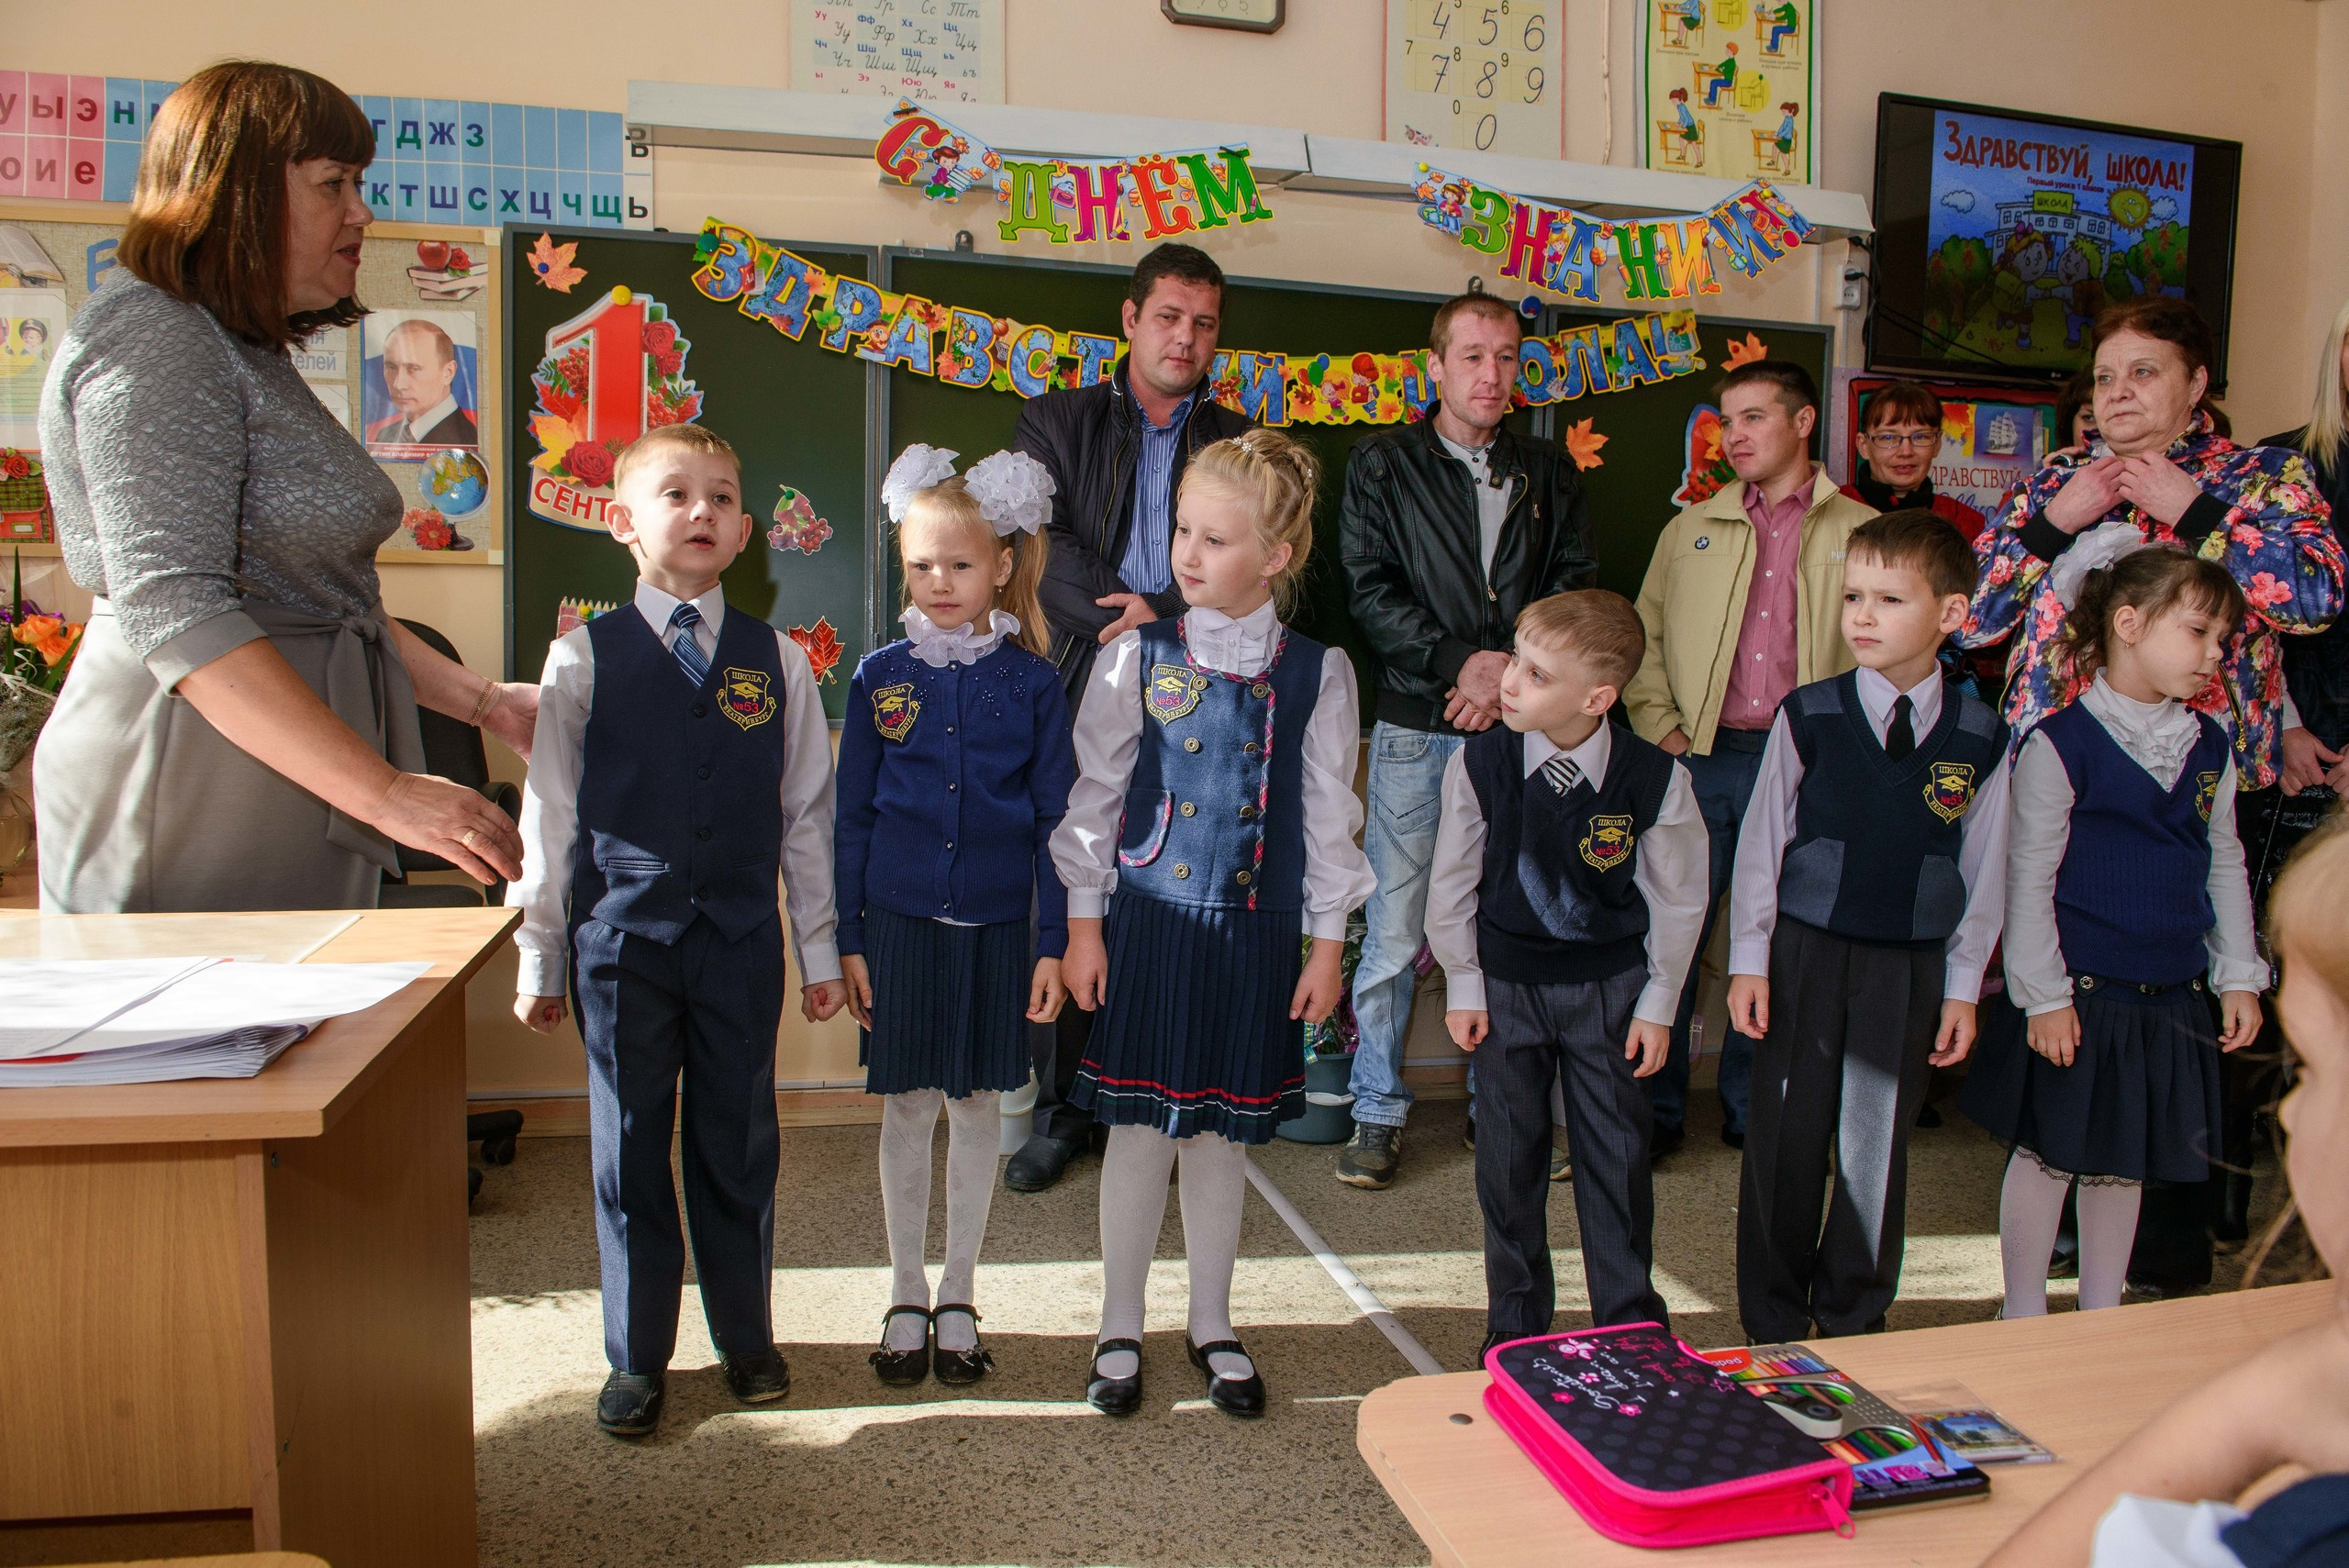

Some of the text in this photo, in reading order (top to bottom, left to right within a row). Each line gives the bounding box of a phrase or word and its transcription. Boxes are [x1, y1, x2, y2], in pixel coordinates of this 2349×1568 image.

[1501, 0, 1509, 15] 6
[815, 10, 828, 20] Уу
[857, 14, 875, 25] Фф
[1432, 1, 1450, 39] 4
[901, 18, 913, 28] Хх
[943, 23, 958, 32] Цц
[1477, 8, 1498, 46] 5
[1524, 15, 1545, 52] 6
[815, 39, 828, 49] Чч
[857, 43, 877, 53] Шш
[1406, 39, 1414, 55] 7
[901, 47, 922, 59] Щщ
[1453, 47, 1462, 61] 8
[1501, 52, 1509, 68] 9
[858, 73, 870, 83] Ээ
[1431, 54, 1451, 93] 7
[1475, 61, 1497, 98] 8
[901, 77, 922, 87] Юю
[943, 81, 956, 89] Яя
[1523, 67, 1545, 104] 9
[1453, 99, 1461, 115] 0
[32, 95, 63, 119] ы
[76, 98, 97, 122] э
[114, 100, 135, 125] н
[396, 120, 422, 150] д
[429, 121, 456, 145] ж
[466, 123, 484, 147] з
[1475, 114, 1497, 150] 0
[2027, 176, 2054, 186] Первый
[0, 157, 21, 181] о
[36, 159, 56, 183] и
[74, 161, 95, 184] е
[371, 183, 389, 206] к
[399, 185, 418, 206] т
[429, 185, 458, 209] ш
[468, 186, 488, 210] с
[500, 189, 520, 213] х
[529, 192, 551, 219] ц
[562, 193, 581, 216] ч
[592, 195, 621, 223] щ
[629, 196, 648, 218] ь
[2036, 195, 2068, 209] ШКОЛА
[875, 117, 1801, 303] С ДНЁМ ЗНАНИЙ!
[295, 351, 337, 371] елей
[1397, 312, 1672, 422] ШОЛА!
[551, 298, 648, 447] 1
[1929, 466, 2021, 490] ДРАВСТВУЙ
[534, 477, 613, 523] СЕНТ
[731, 672, 763, 683] ШКОЛА
[1158, 667, 1188, 678] ШКОЛА
[878, 687, 906, 699] ШКОЛА
[733, 701, 759, 714] №53
[1156, 695, 1181, 706] №53
[723, 705, 769, 725] ЕКАТЕРИНБУРГ
[885, 711, 905, 728] №53
[1939, 766, 1968, 775] ШКОЛА
[1941, 795, 1963, 806] №53
[1598, 818, 1627, 827] ШКОЛА
[1596, 845, 1620, 855] №53
[1712, 1355, 1743, 1368] aped
